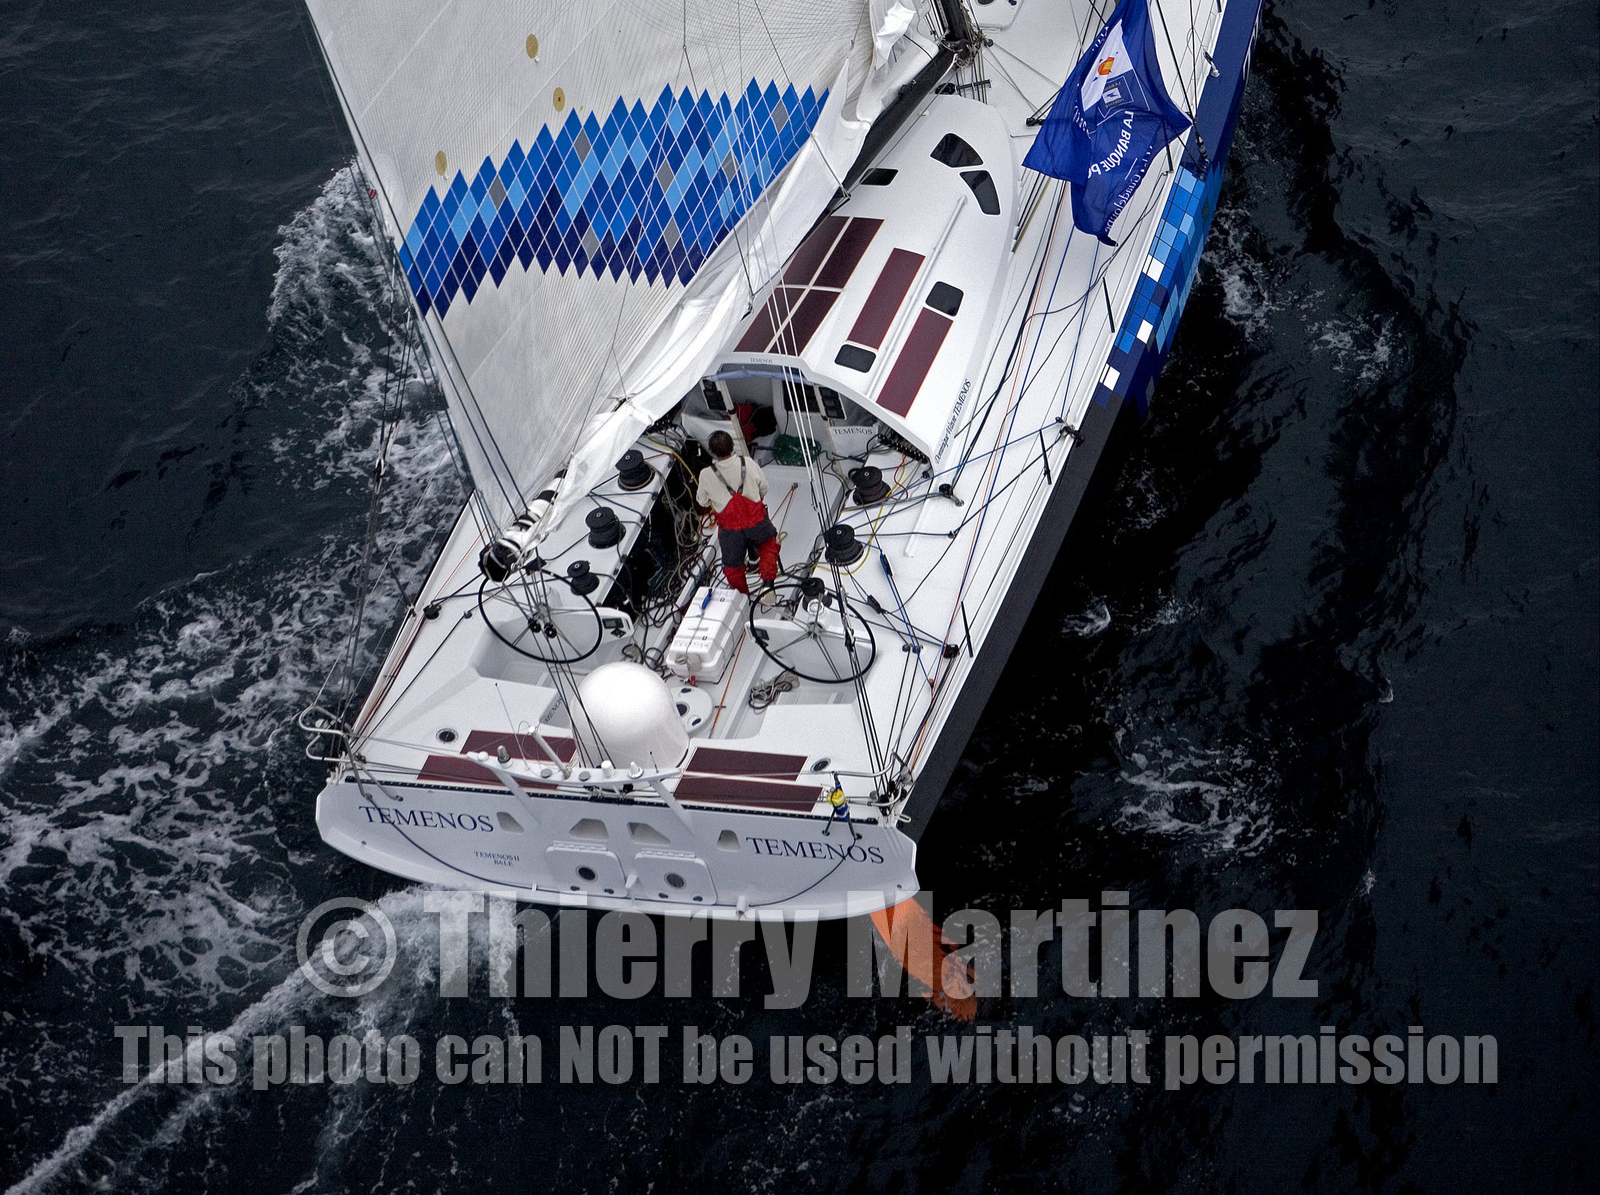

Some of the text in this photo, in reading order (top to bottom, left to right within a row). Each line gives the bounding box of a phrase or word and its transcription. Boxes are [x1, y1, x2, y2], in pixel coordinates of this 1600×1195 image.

[952, 378, 972, 416] TEMENOS
[834, 427, 873, 436] TEMENOS
[358, 805, 494, 834] TEMENOS
[474, 850, 513, 860] TEMENOS
[746, 836, 885, 866] TEMENOS
